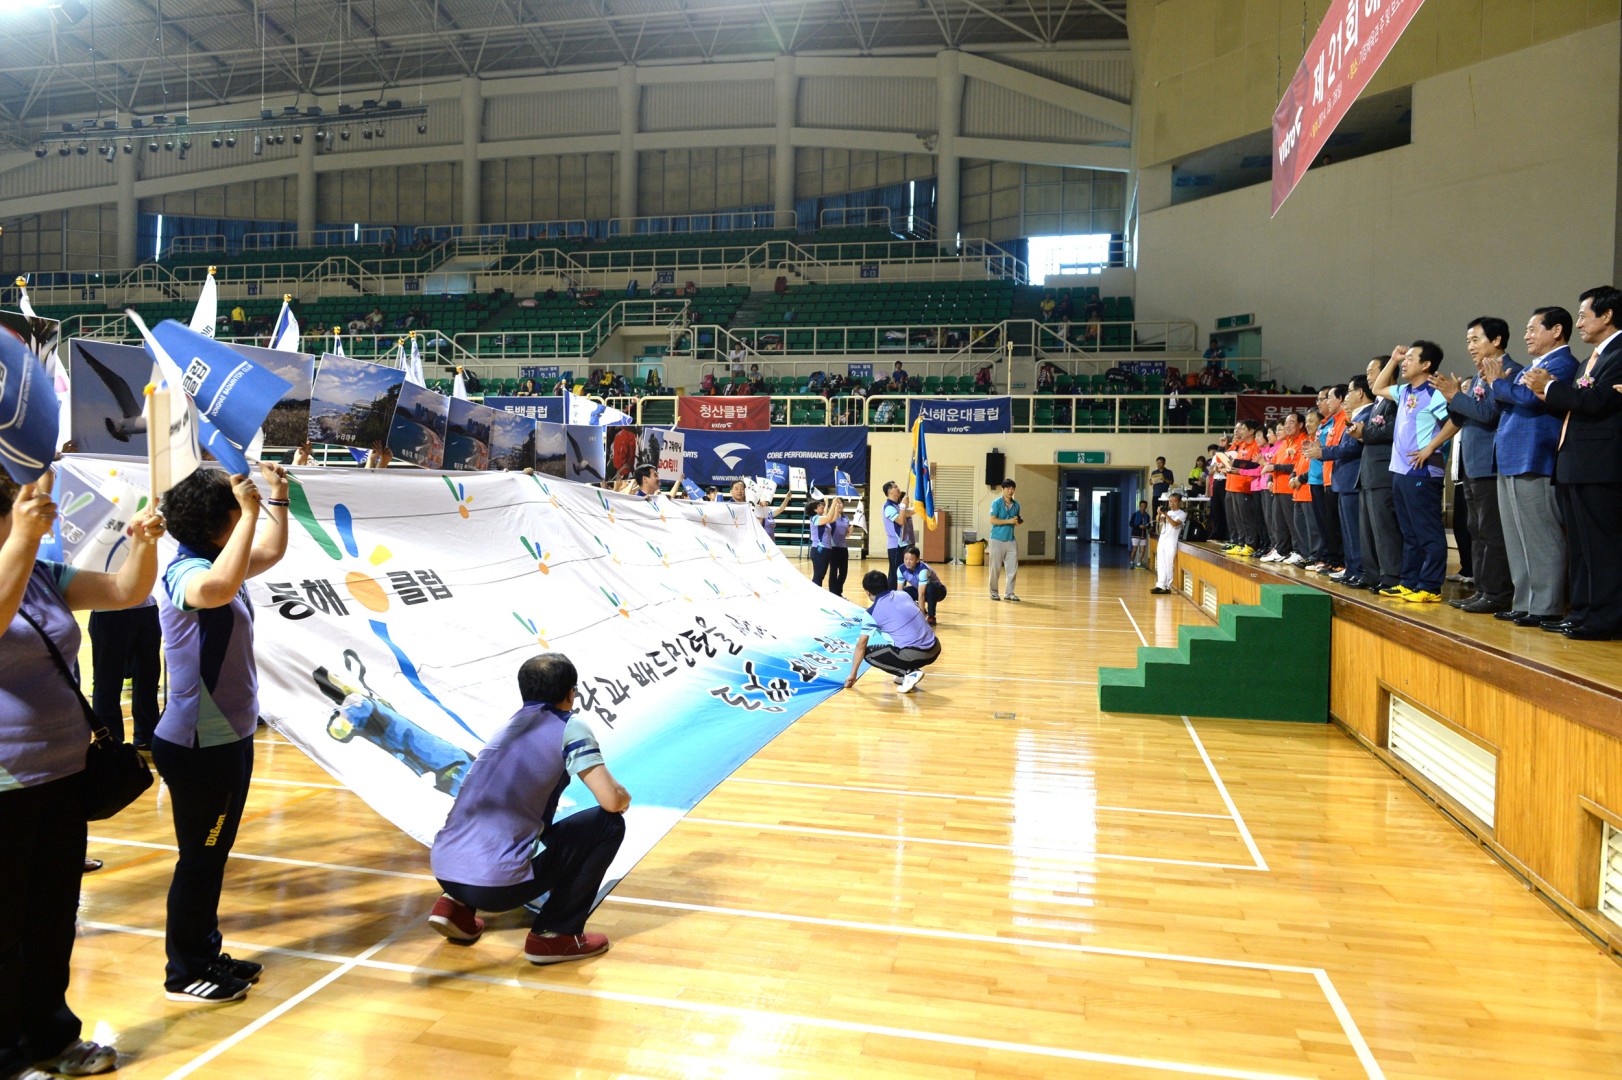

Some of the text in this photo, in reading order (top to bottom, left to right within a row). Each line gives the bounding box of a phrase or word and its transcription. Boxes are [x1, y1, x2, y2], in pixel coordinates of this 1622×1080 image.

[1313, 49, 1325, 107] 제
[700, 404, 748, 419] 청산클럽
[921, 407, 999, 421] 신해운대클럽
[265, 578, 350, 620] 동해
[386, 569, 454, 606] 클럽
[205, 813, 227, 847] Wilson
